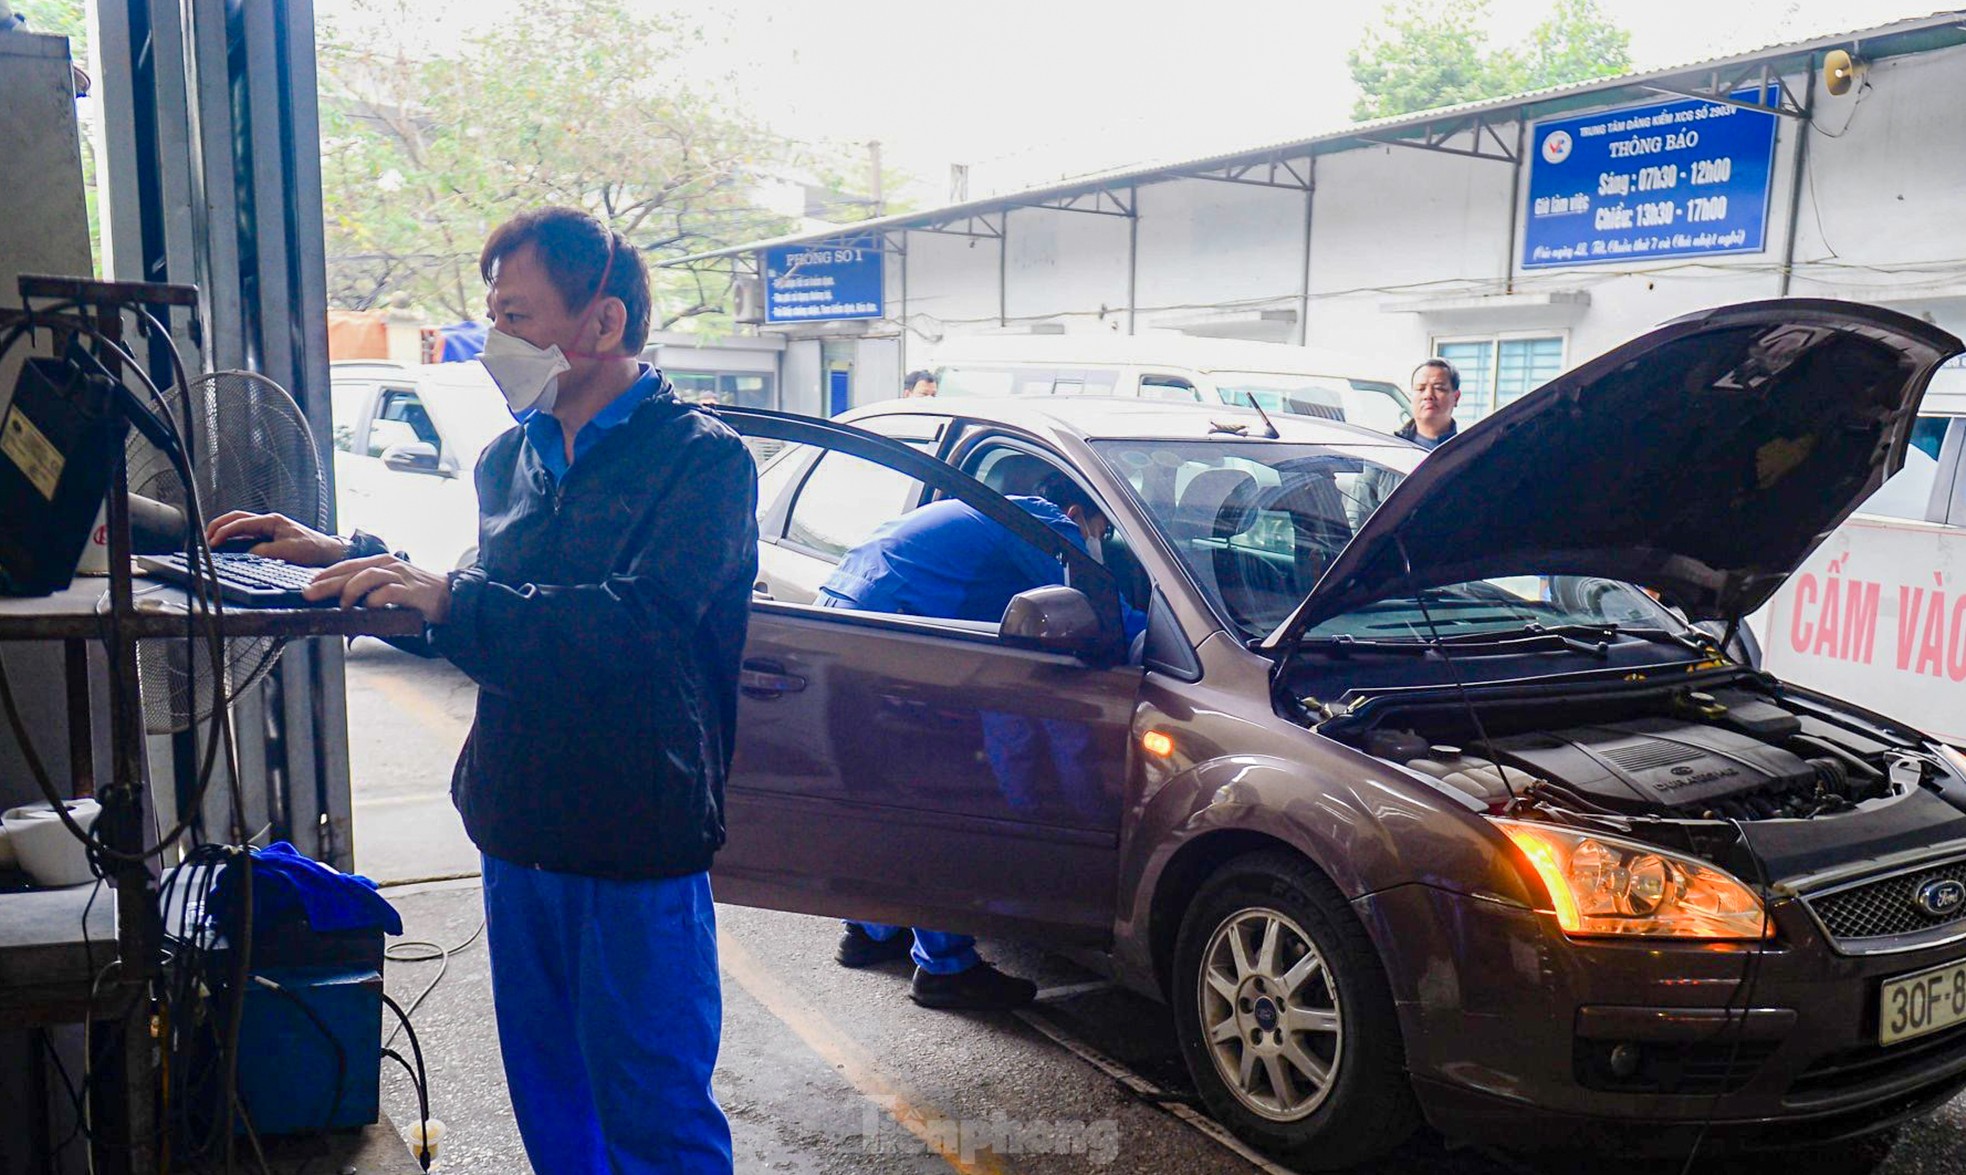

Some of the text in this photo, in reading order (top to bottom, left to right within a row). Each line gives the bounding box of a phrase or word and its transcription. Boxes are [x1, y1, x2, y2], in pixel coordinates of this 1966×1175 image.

[1579, 124, 1606, 138] TRUNG
[1607, 120, 1626, 134] TÂM
[1695, 103, 1709, 121] SỐ
[1608, 126, 1699, 159] THÔNG BÁO
[1598, 170, 1630, 197] Sáng
[1638, 164, 1678, 192] 07h30
[1690, 157, 1732, 186] 12h00
[1636, 200, 1675, 228] 13h30
[1686, 195, 1729, 223] 17h00
[1790, 551, 1881, 665] CẤM
